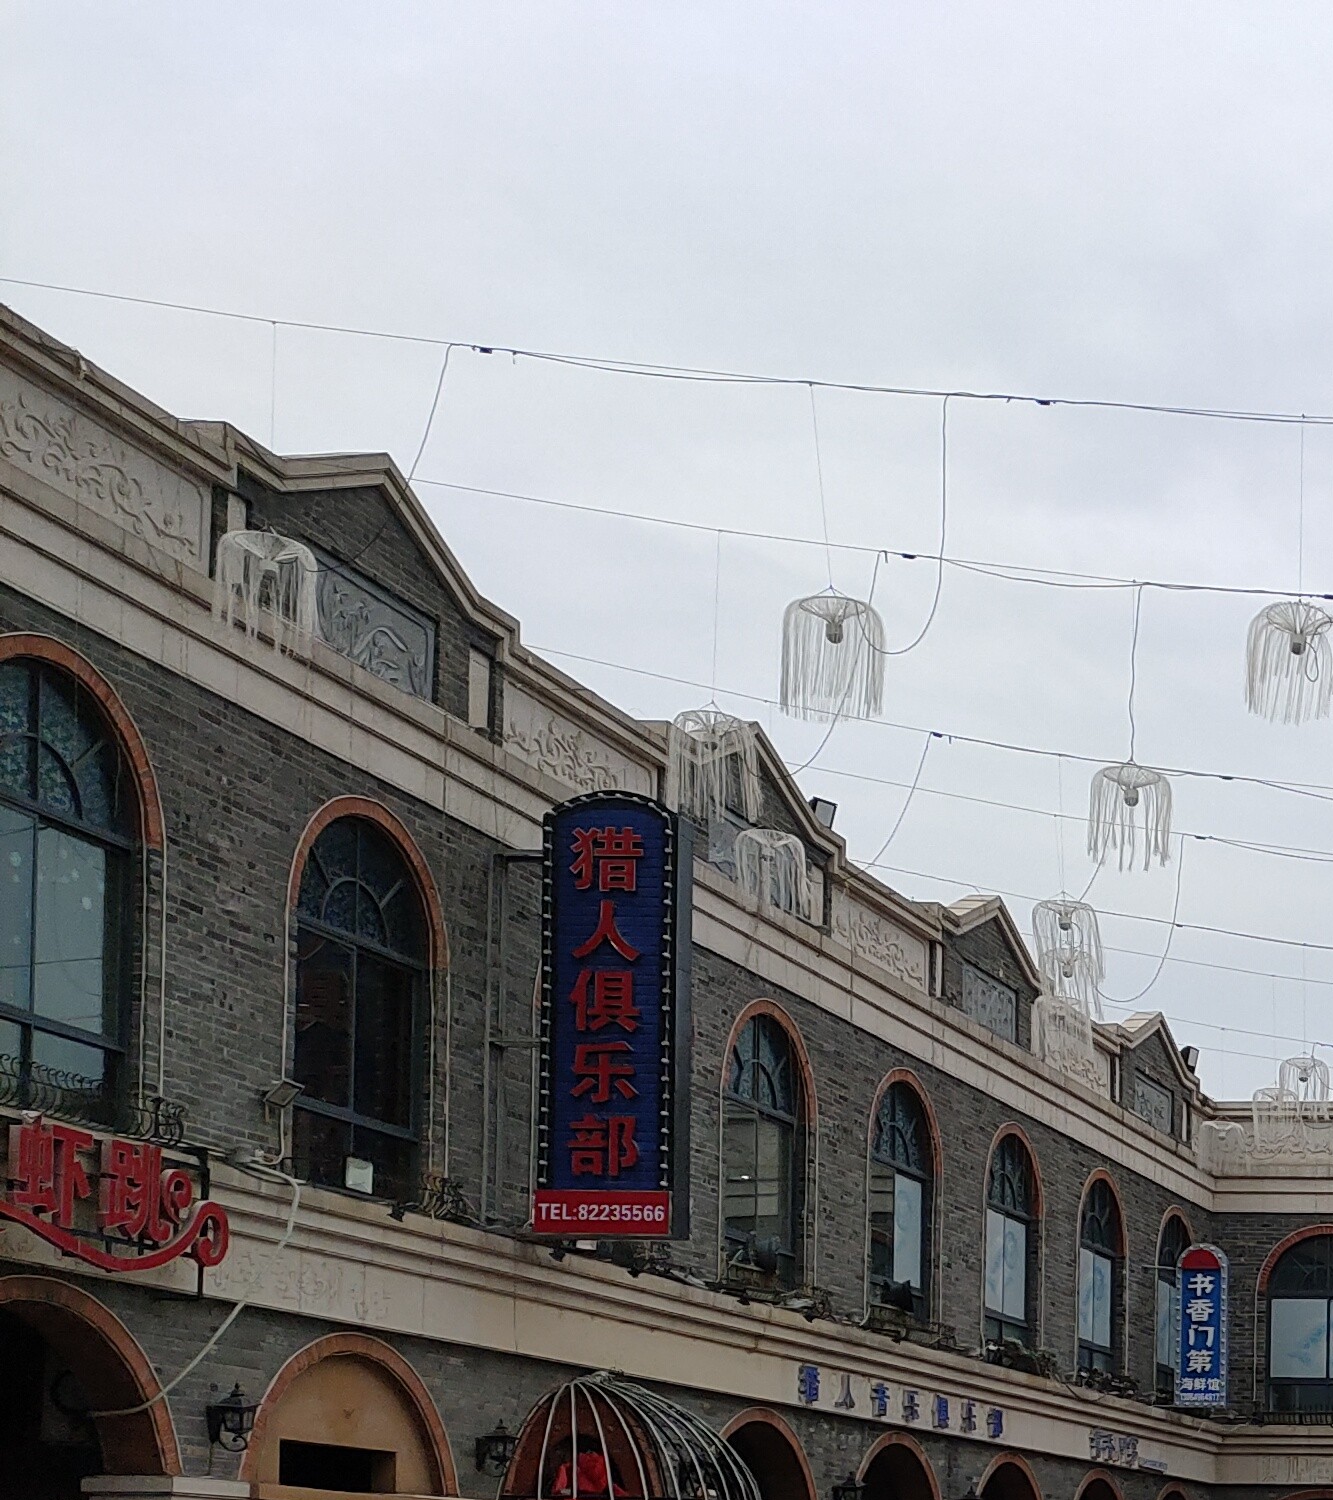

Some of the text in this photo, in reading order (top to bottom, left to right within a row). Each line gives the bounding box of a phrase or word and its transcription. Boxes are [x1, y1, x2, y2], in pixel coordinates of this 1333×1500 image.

[567, 826, 644, 1177] 猎人俱乐部
[538, 1203, 665, 1222] TEL:82235566
[1186, 1273, 1215, 1373] 书香门第
